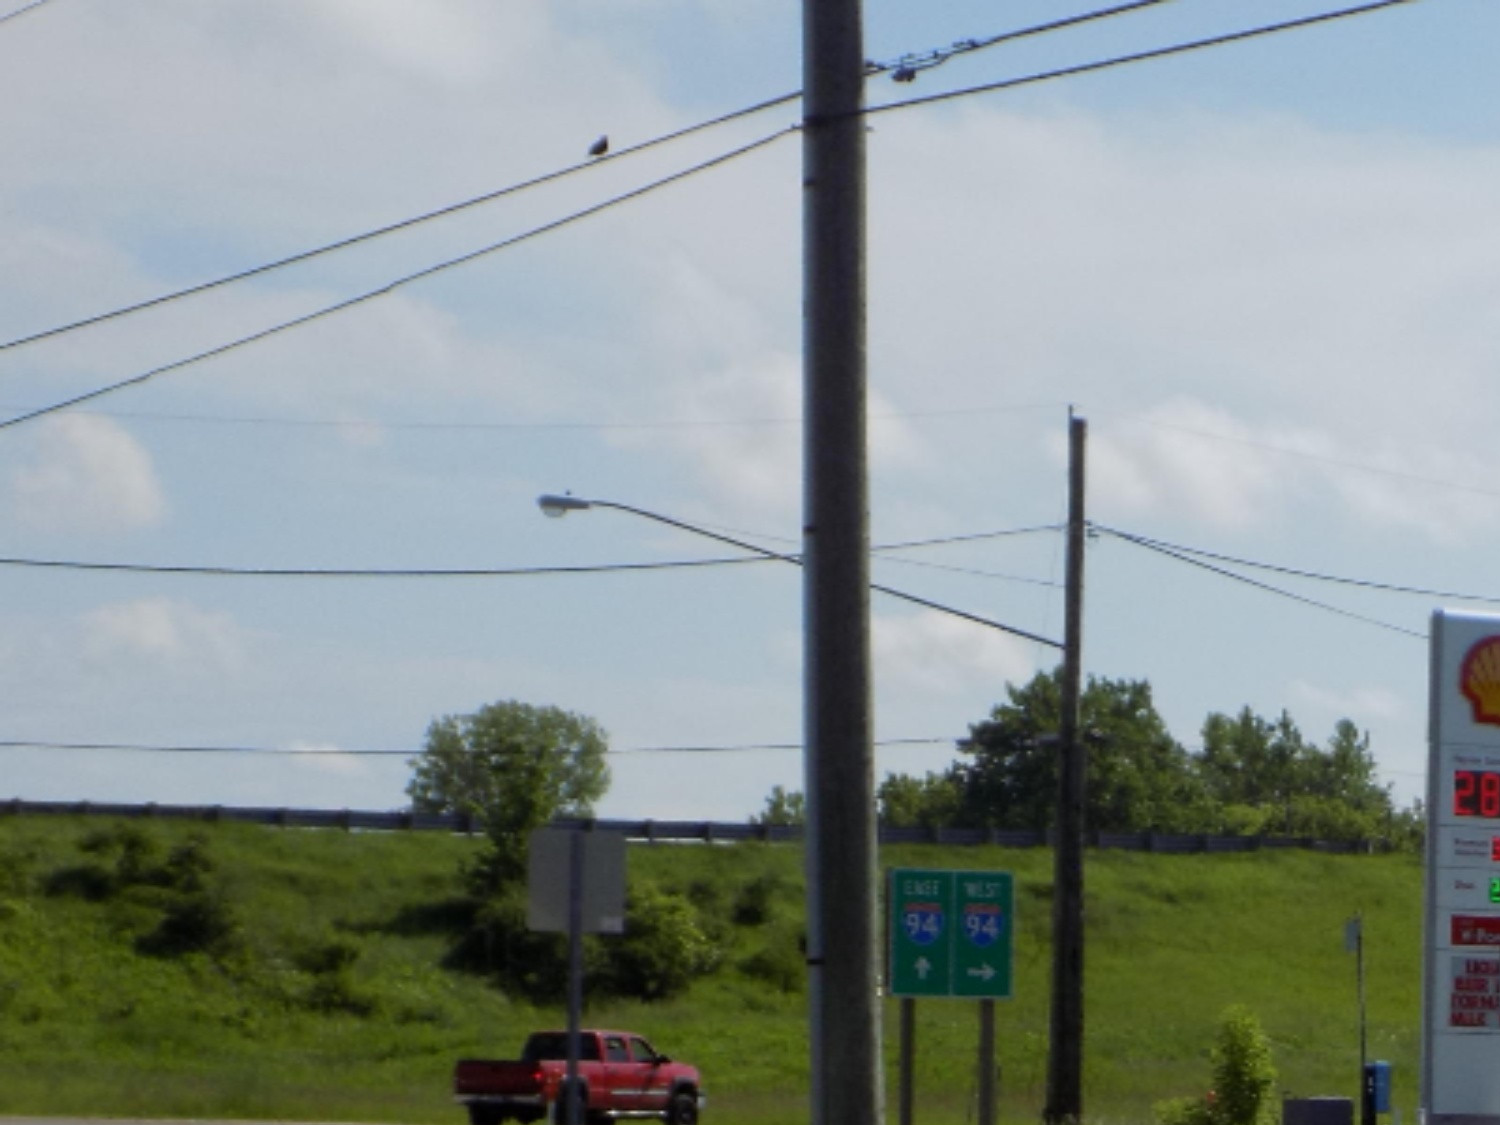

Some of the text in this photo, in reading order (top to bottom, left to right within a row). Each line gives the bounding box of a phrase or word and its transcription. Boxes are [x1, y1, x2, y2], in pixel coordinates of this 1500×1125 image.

[963, 881, 1002, 898] WEST
[906, 912, 938, 935] 94
[966, 913, 999, 937] 94
